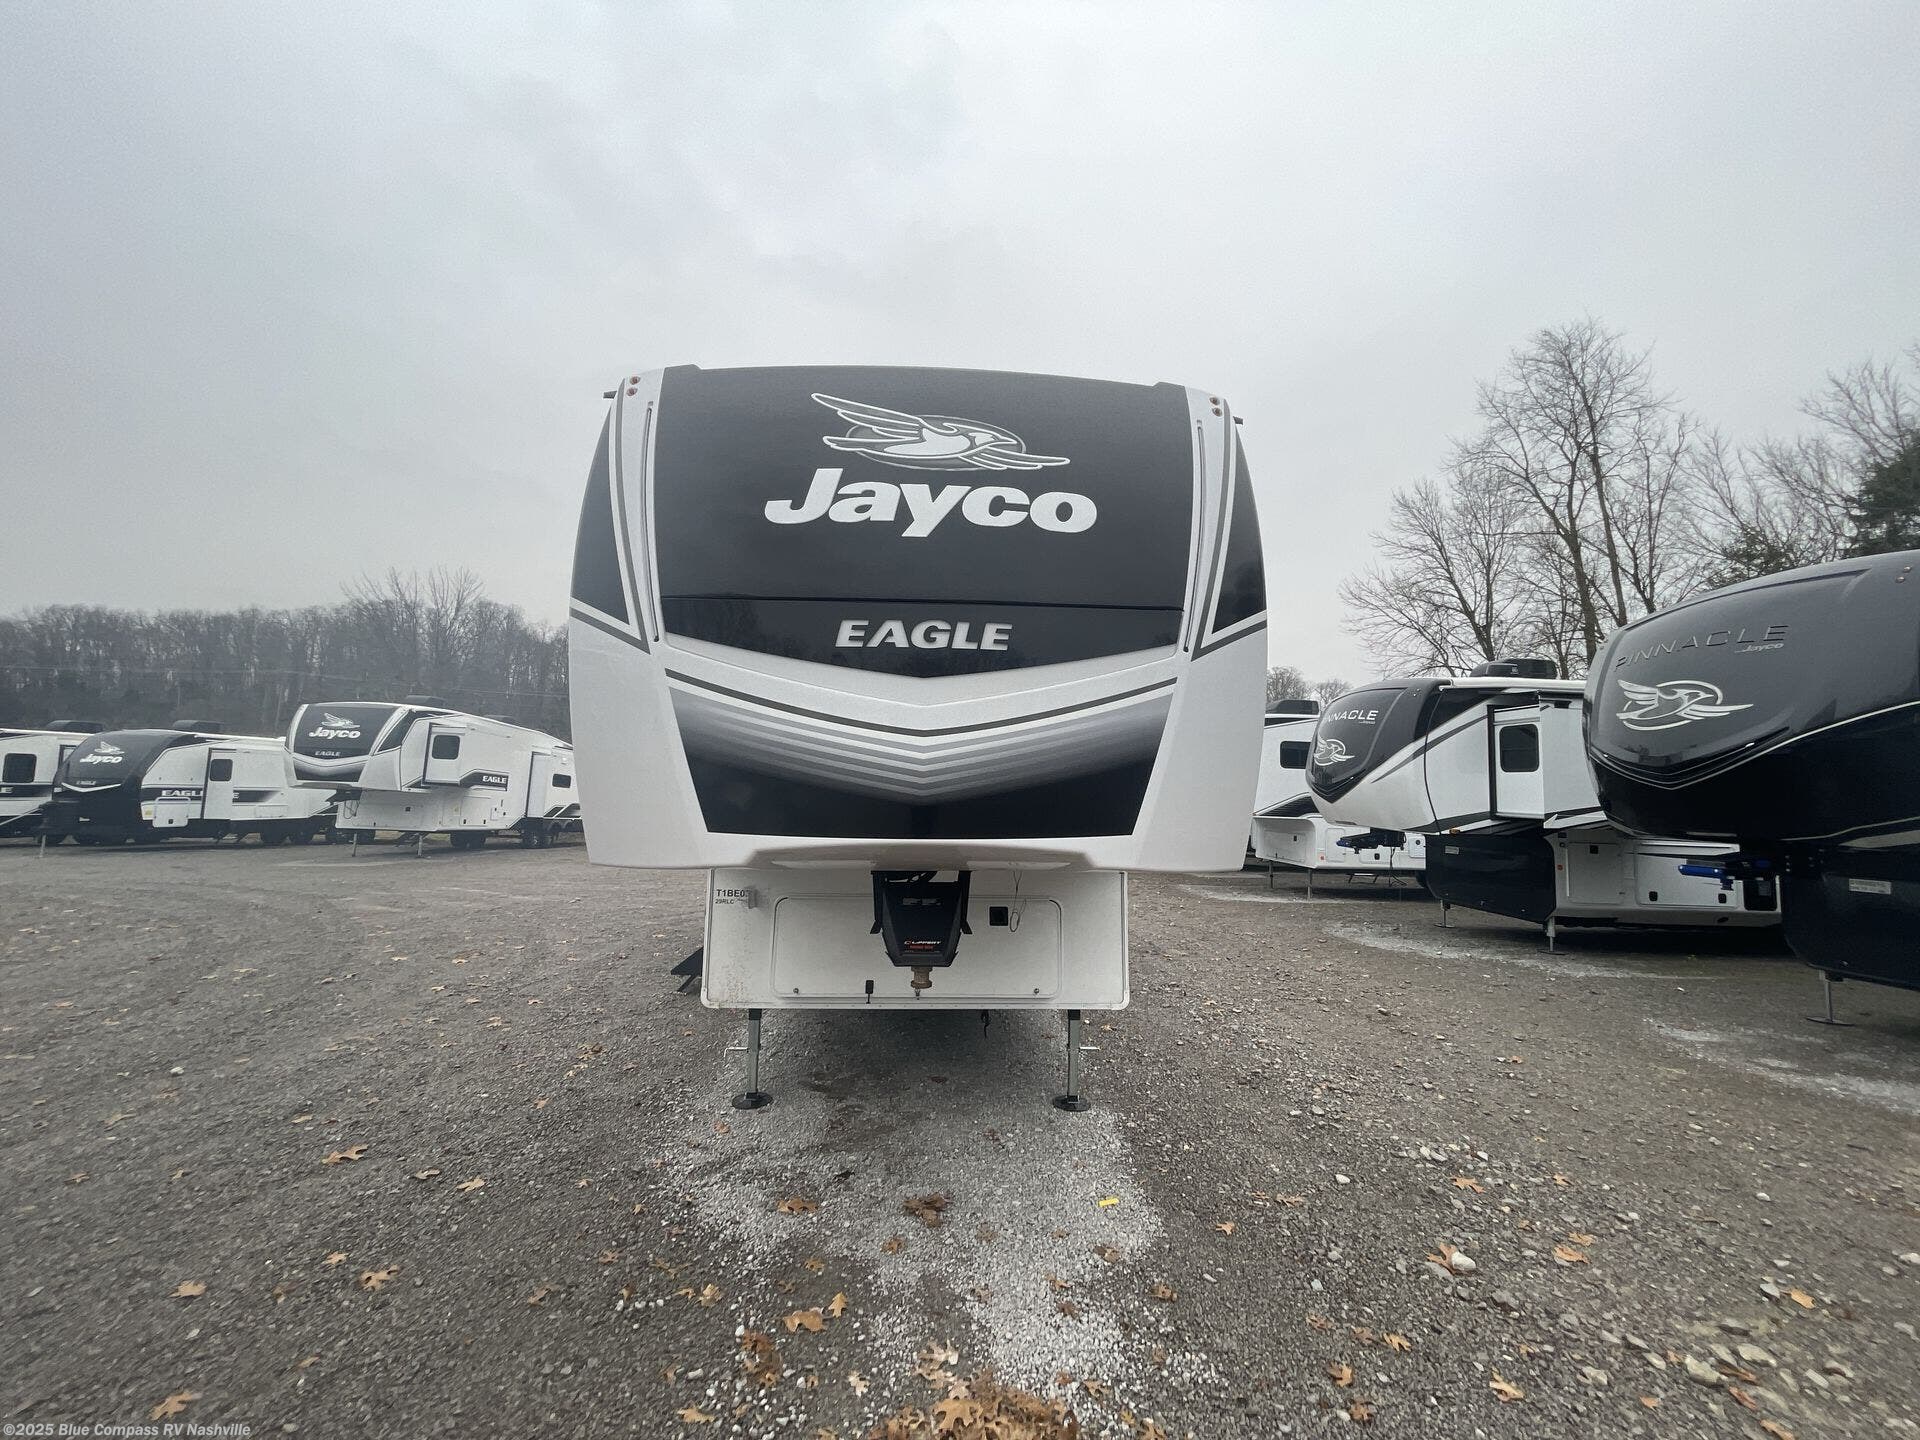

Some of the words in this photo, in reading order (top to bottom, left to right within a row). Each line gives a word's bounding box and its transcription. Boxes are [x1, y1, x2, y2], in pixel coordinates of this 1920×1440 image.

[764, 467, 1098, 538] Jayco
[835, 619, 1013, 651] EAGLE
[1615, 625, 1789, 672] PINNACLE
[1736, 643, 1785, 653] Jayco
[308, 726, 361, 740] Jayco
[79, 753, 123, 765] Jayco
[482, 775, 507, 784] EAGLE
